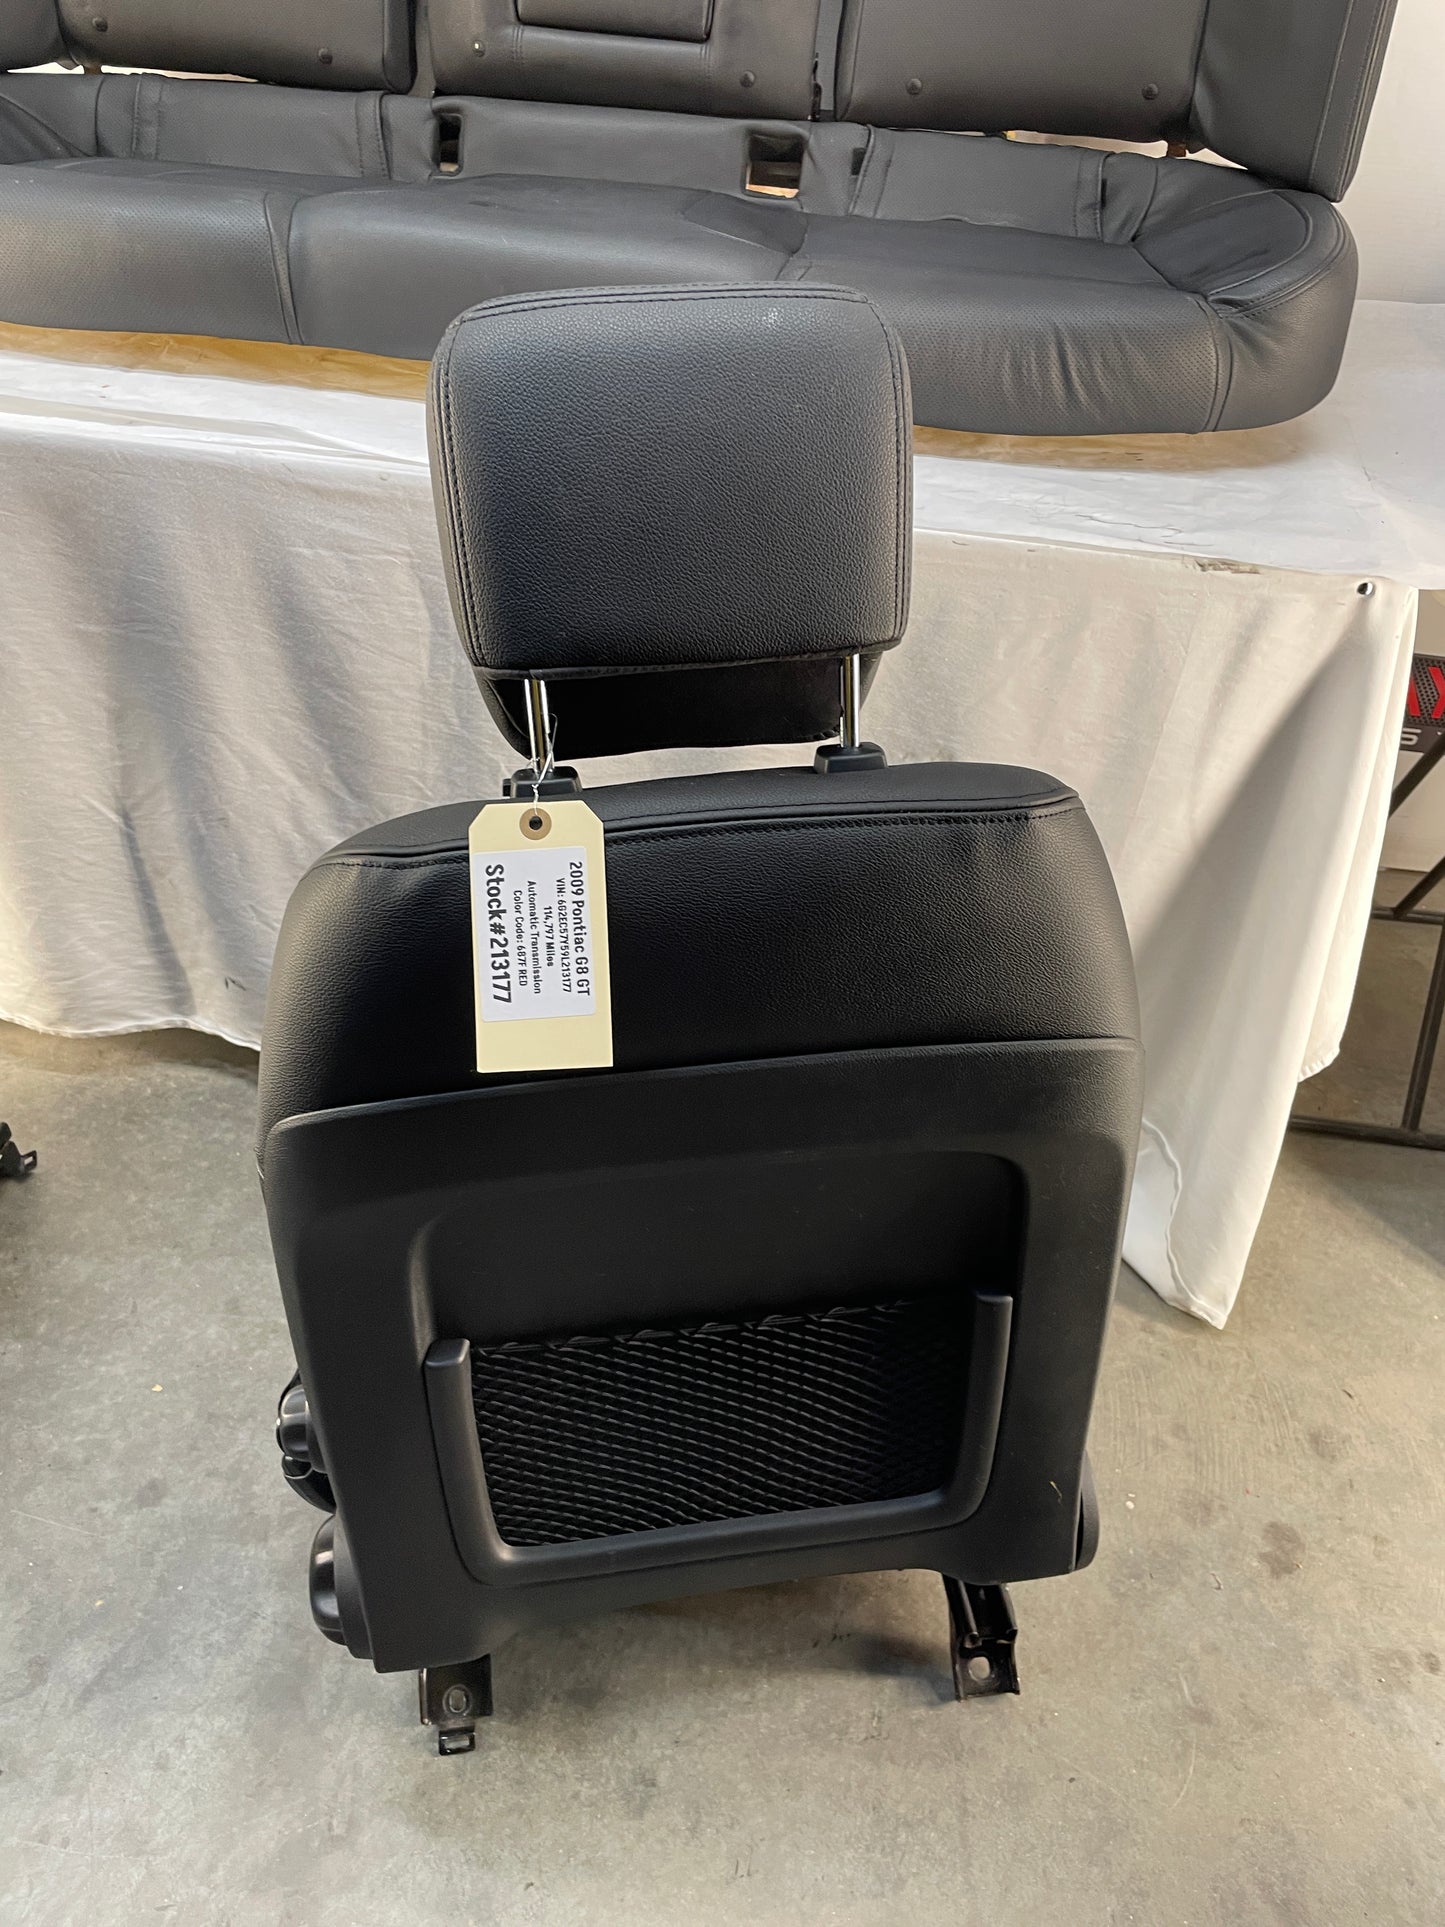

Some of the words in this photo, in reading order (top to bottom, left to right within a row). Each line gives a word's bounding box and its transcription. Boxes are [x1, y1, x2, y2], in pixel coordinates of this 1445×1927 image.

[556, 878, 565, 897] VIN:
[570, 862, 584, 896] 2009
[514, 890, 523, 914] Color
[528, 881, 539, 929] Automatic
[485, 864, 512, 1003] Stock#213177
[515, 917, 524, 944] Code:
[543, 906, 554, 940] 114,797
[572, 900, 586, 953] Pontiac
[517, 945, 527, 967] 687F
[530, 931, 541, 994] Transmission
[546, 942, 555, 967] Miles
[576, 957, 588, 974] G8
[518, 969, 528, 986] RED
[577, 979, 590, 996] GT
